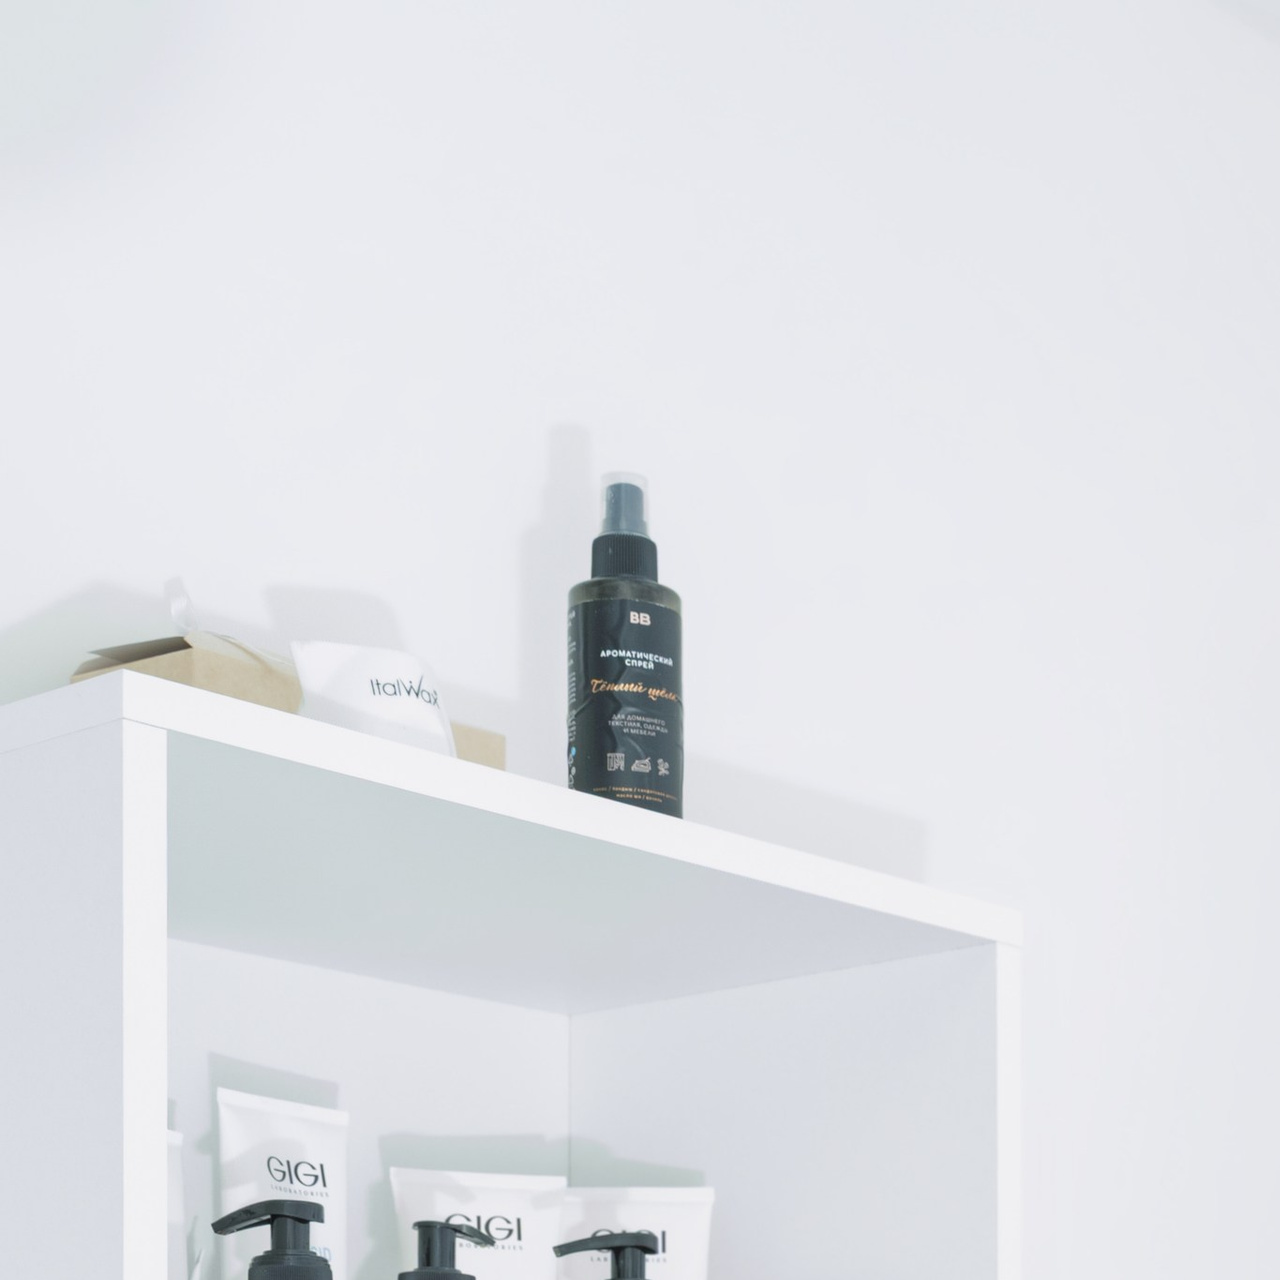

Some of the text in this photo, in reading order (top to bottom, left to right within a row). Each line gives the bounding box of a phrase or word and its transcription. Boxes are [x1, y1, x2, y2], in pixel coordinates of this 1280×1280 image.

[629, 610, 651, 626] BB
[599, 649, 674, 667] АРОМАТИЧЕСКИЙ
[624, 658, 655, 670] СПРЕЙ
[369, 674, 440, 710] ItalWax
[266, 1155, 328, 1189] GIGI
[270, 1183, 330, 1198] LABORATORIES
